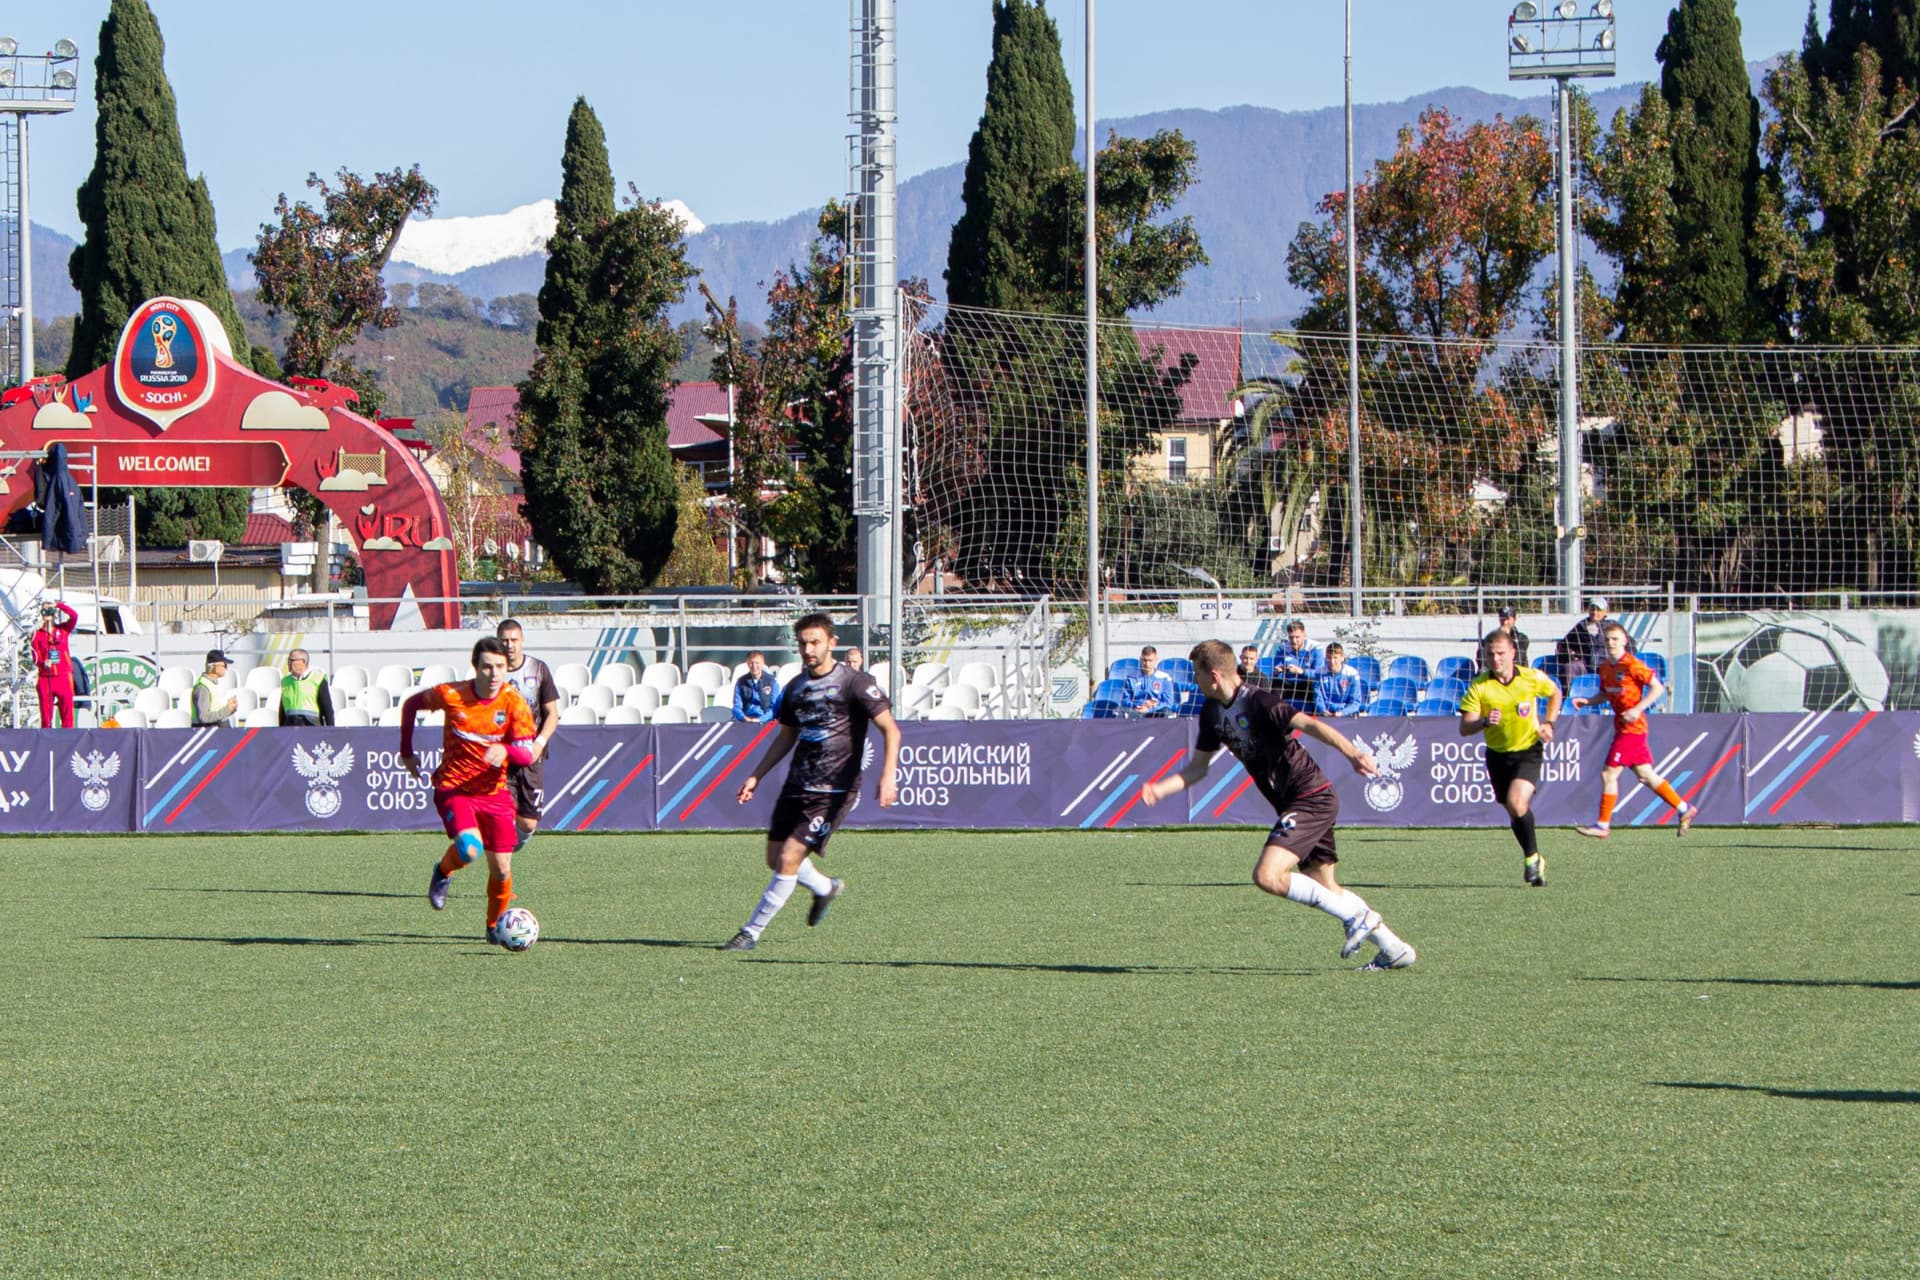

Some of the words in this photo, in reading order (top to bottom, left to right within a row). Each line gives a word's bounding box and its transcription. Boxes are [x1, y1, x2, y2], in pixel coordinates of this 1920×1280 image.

[145, 391, 182, 404] SOCHI
[118, 456, 211, 471] WELCOME!
[1200, 602, 1233, 610] СЕКОР
[899, 742, 1031, 765] ОССИЙСКИЙ
[366, 791, 428, 810] СОЮЗ
[1430, 784, 1496, 803] СОЮЗ
[808, 816, 831, 836] 89
[1281, 812, 1298, 831] 6
